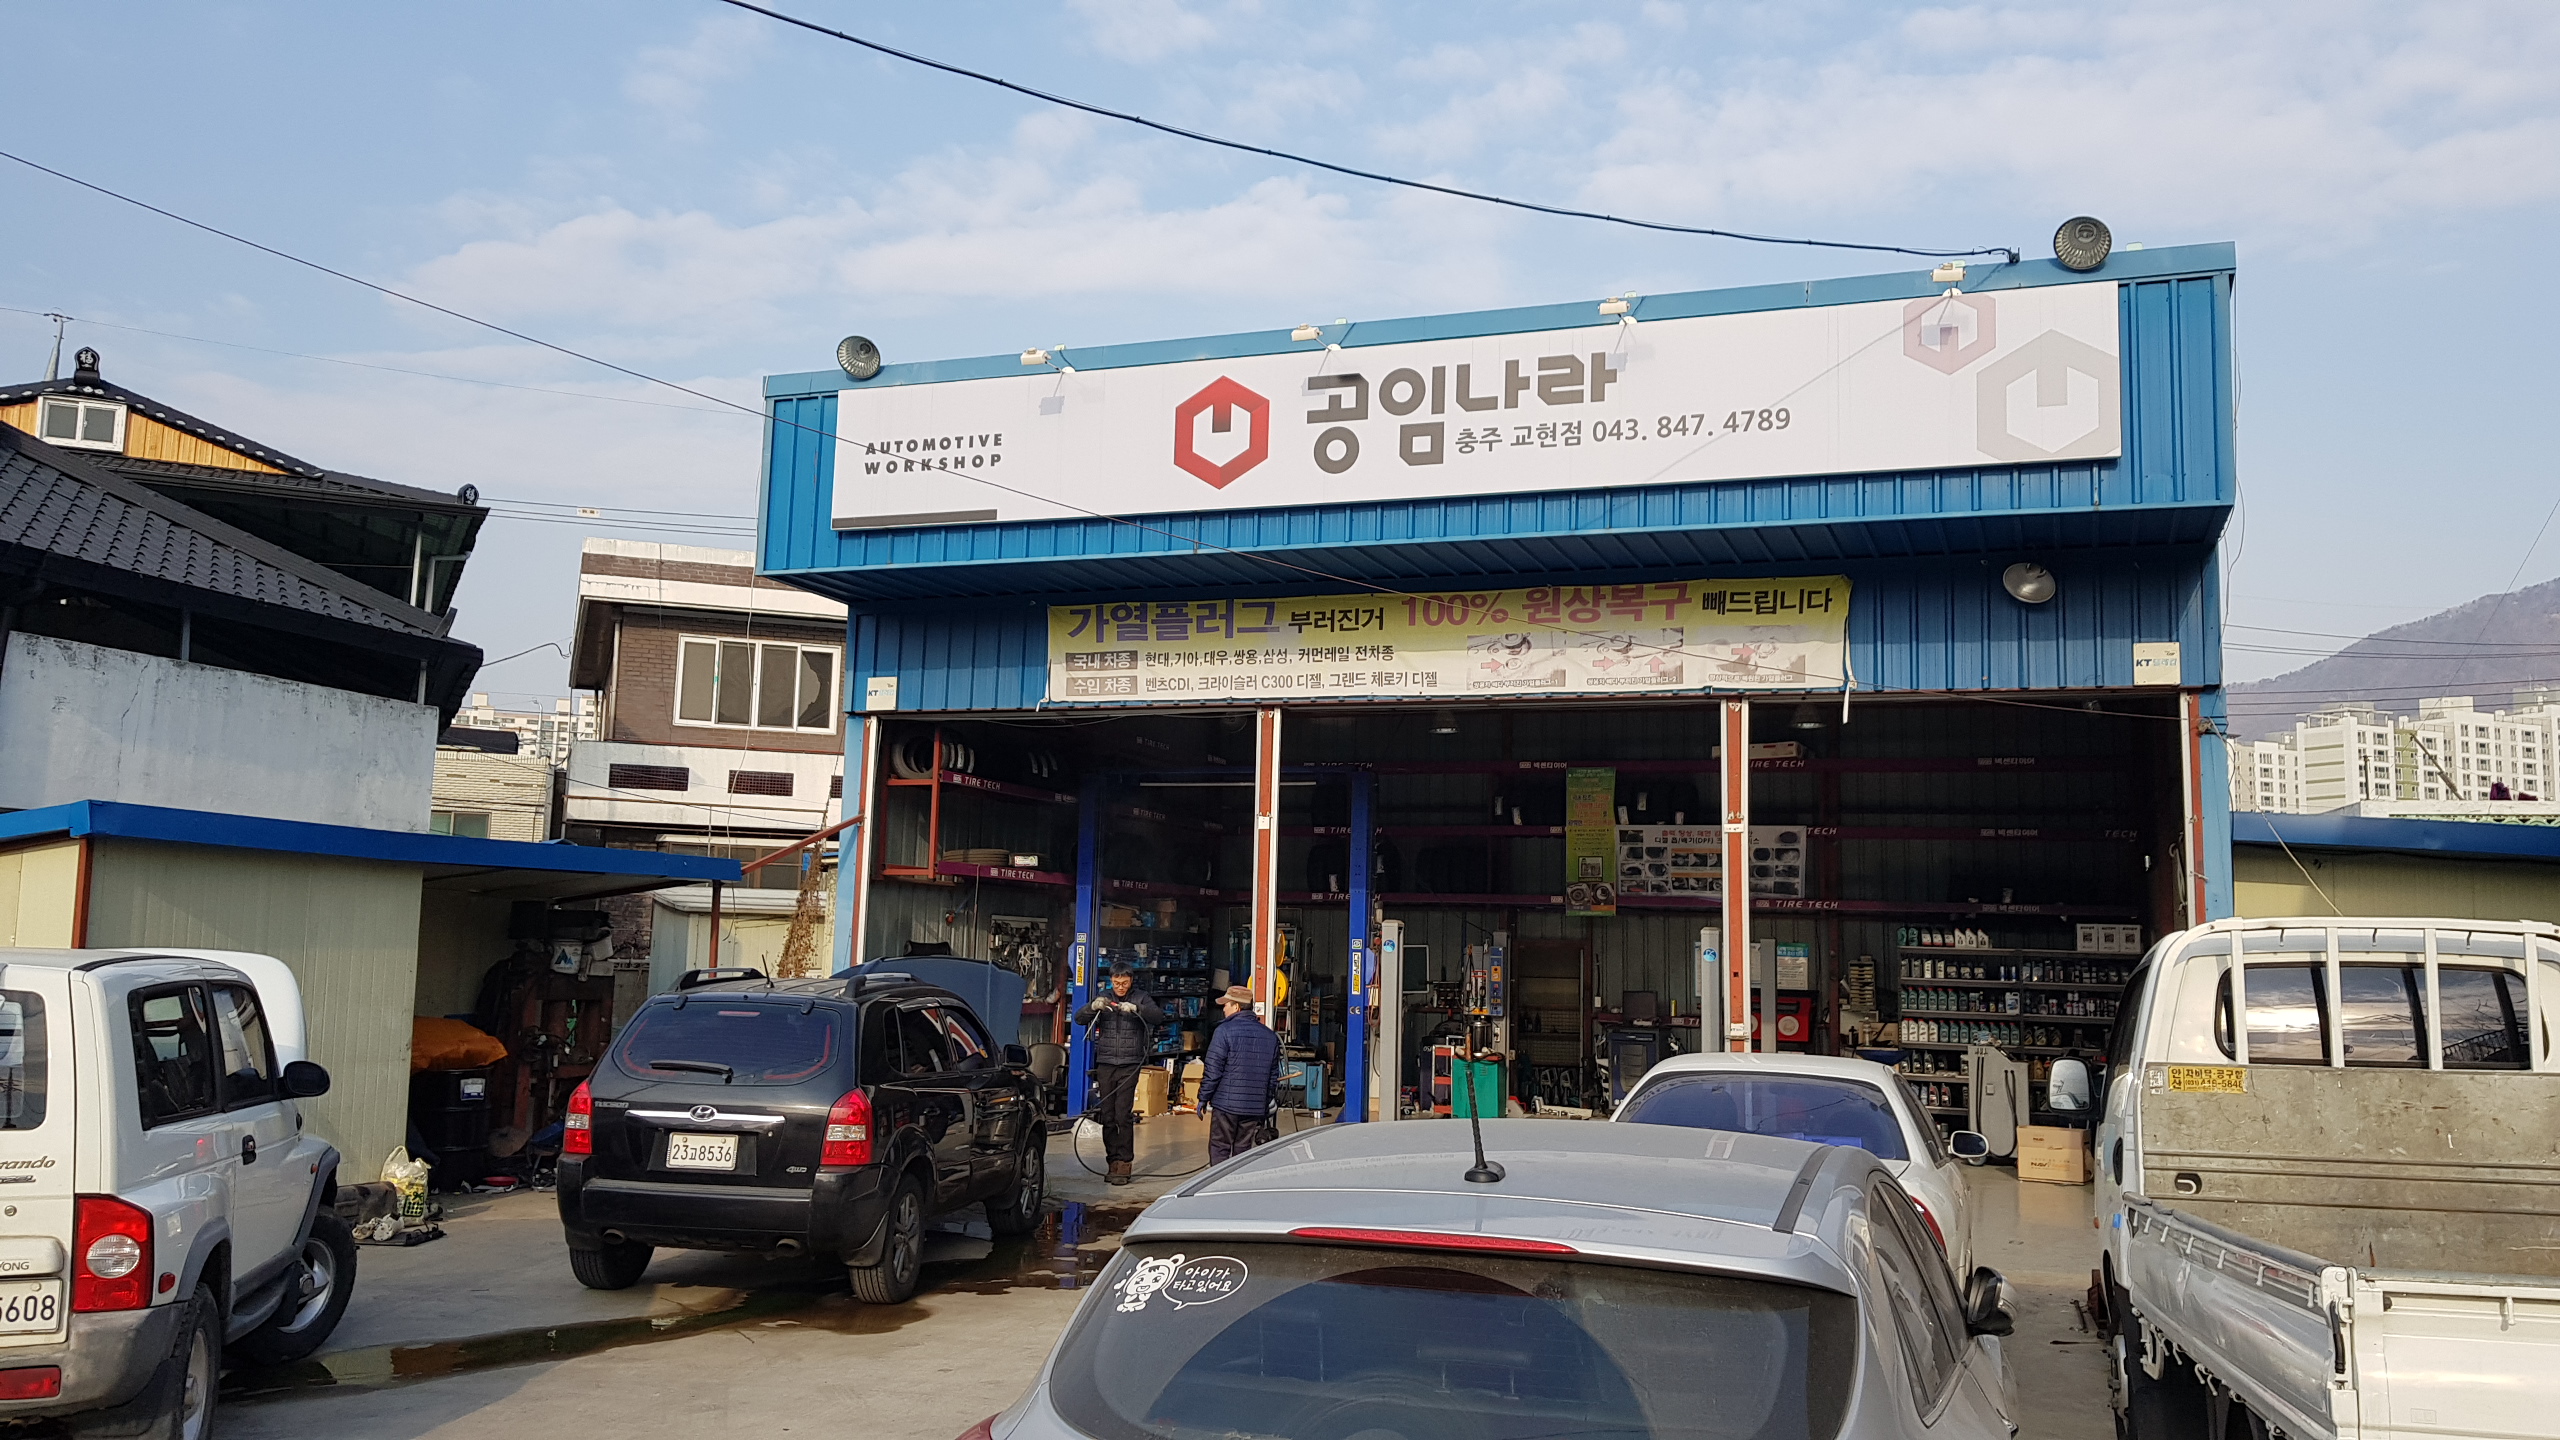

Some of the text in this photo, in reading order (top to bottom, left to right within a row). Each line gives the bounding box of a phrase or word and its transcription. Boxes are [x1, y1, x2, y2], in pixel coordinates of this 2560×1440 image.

[1306, 352, 1618, 474] 공임나라
[1455, 407, 1791, 454] 충주 교현점 043. 847. 4789
[865, 433, 1003, 455] AUTOMOTIVE
[864, 453, 1002, 475] WORKSHOP
[1067, 583, 1833, 643] 가열플러그 부러진거 100% 원상복구 빼드립니다
[1073, 653, 1100, 670] 국내
[1105, 652, 1131, 669] 차종
[1298, 646, 1350, 663] 커먼레일
[1354, 645, 1395, 661] 전차종
[2136, 659, 2152, 667] KT
[1073, 678, 1100, 694] 수입
[1105, 677, 1131, 693] 차종
[1197, 675, 1258, 692] 크라이슬러
[1261, 675, 1293, 689] C300
[1296, 673, 1325, 689] 디젤,
[1328, 672, 1367, 688] 그랜드
[1371, 671, 1408, 688] 체로키
[1412, 671, 1438, 687] 디젤
[1750, 760, 1805, 768] IRE TECH
[964, 776, 981, 787] TIRE
[983, 780, 1000, 790] TECH
[1806, 827, 1837, 835] TECH
[1001, 868, 1016, 878] TIRE
[1018, 870, 1034, 880] TECH
[1121, 880, 1134, 888] TIRE
[1775, 900, 1803, 908] TIRE
[1807, 901, 1839, 909] TECH
[671, 1144, 732, 1162] 23고8536
[1185, 1266, 1231, 1279] 아이가
[0, 1294, 55, 1322] 608
